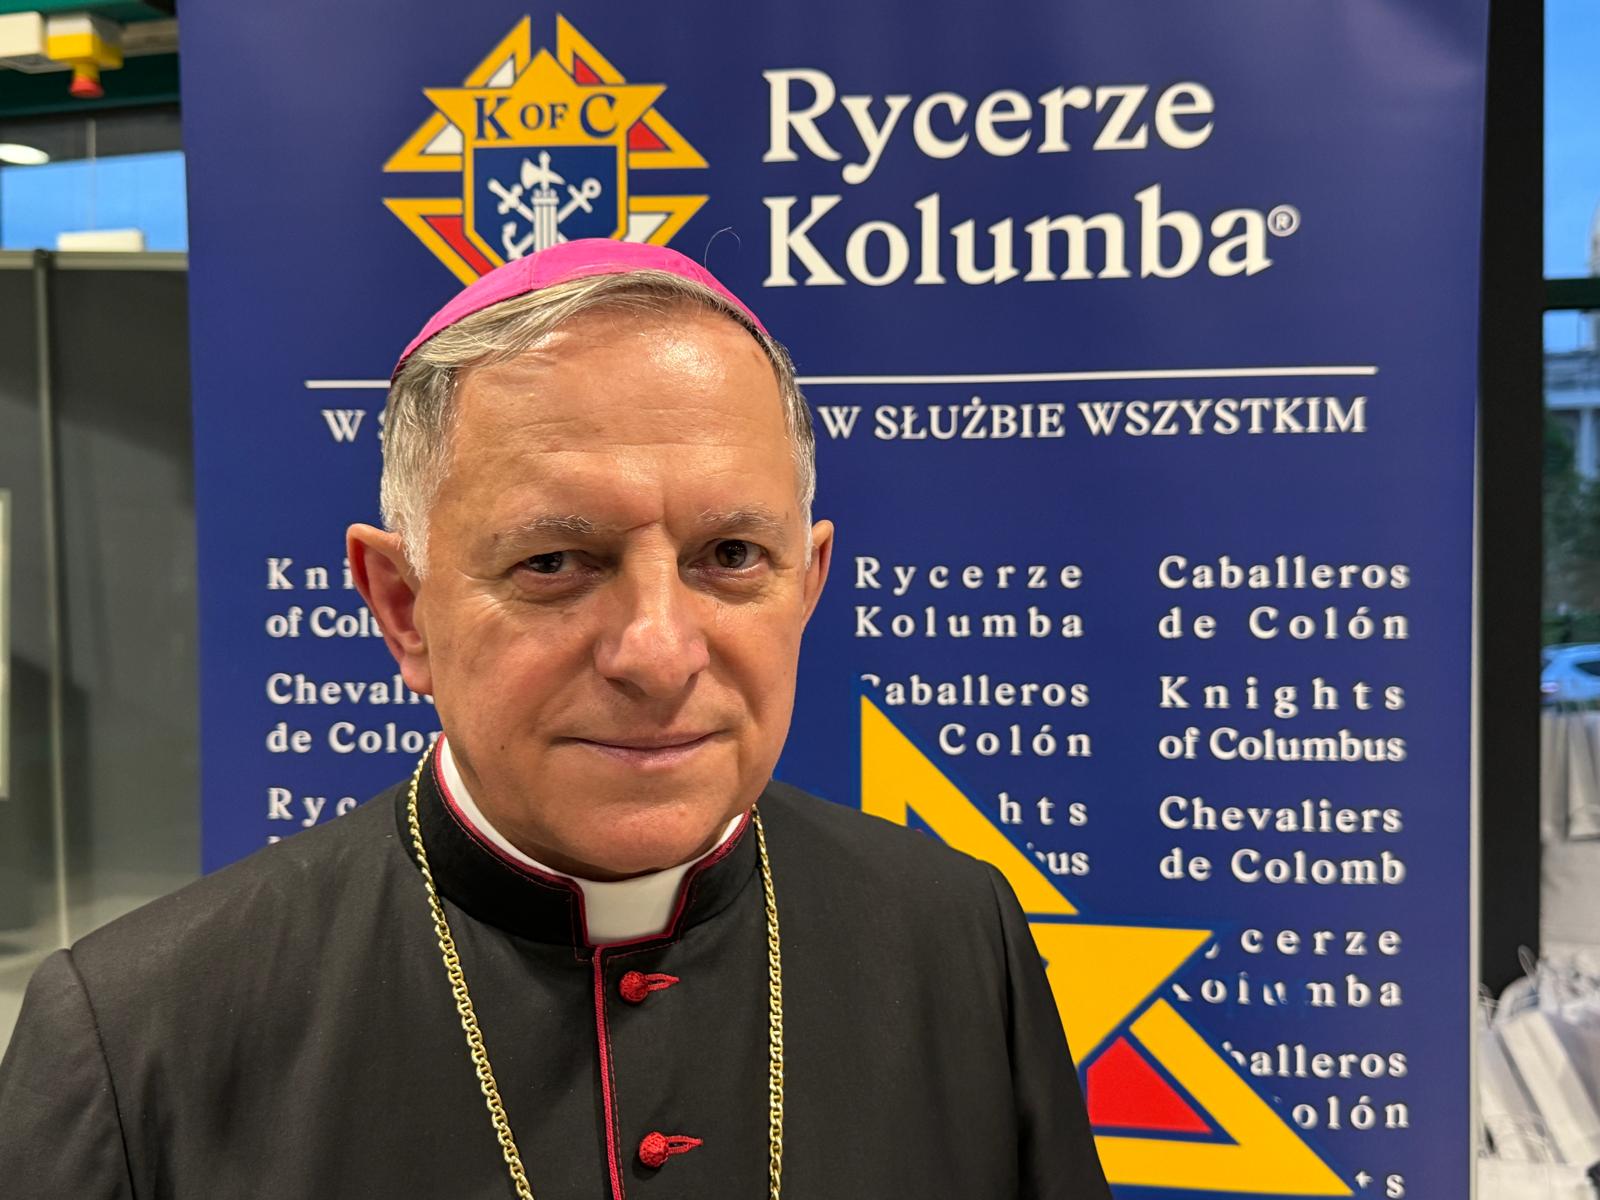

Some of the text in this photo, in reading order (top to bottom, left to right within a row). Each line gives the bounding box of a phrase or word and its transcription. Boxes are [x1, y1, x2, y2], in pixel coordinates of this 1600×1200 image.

[474, 92, 618, 140] K OF C
[762, 68, 1215, 185] Rycerze
[321, 409, 366, 442] W
[817, 406, 861, 440] W
[874, 396, 1065, 440] SŁUŻBIE
[1077, 396, 1367, 436] WSZYSTKIM
[855, 556, 1083, 596] Rycerze
[1158, 555, 1411, 589] Caballeros
[265, 606, 303, 638] of
[855, 606, 1084, 638] Kolumba
[1158, 606, 1409, 640] de Colón
[860, 673, 1090, 707] aballeros
[1159, 675, 1405, 719] Knights
[265, 721, 438, 754] de Colo
[938, 723, 1092, 757] Colón
[1158, 727, 1406, 762] of Columbus
[1158, 795, 1403, 833] Chevaliers
[1027, 842, 1091, 876] us
[1158, 847, 1407, 885] de Colomb
[1273, 1095, 1410, 1131] olón
